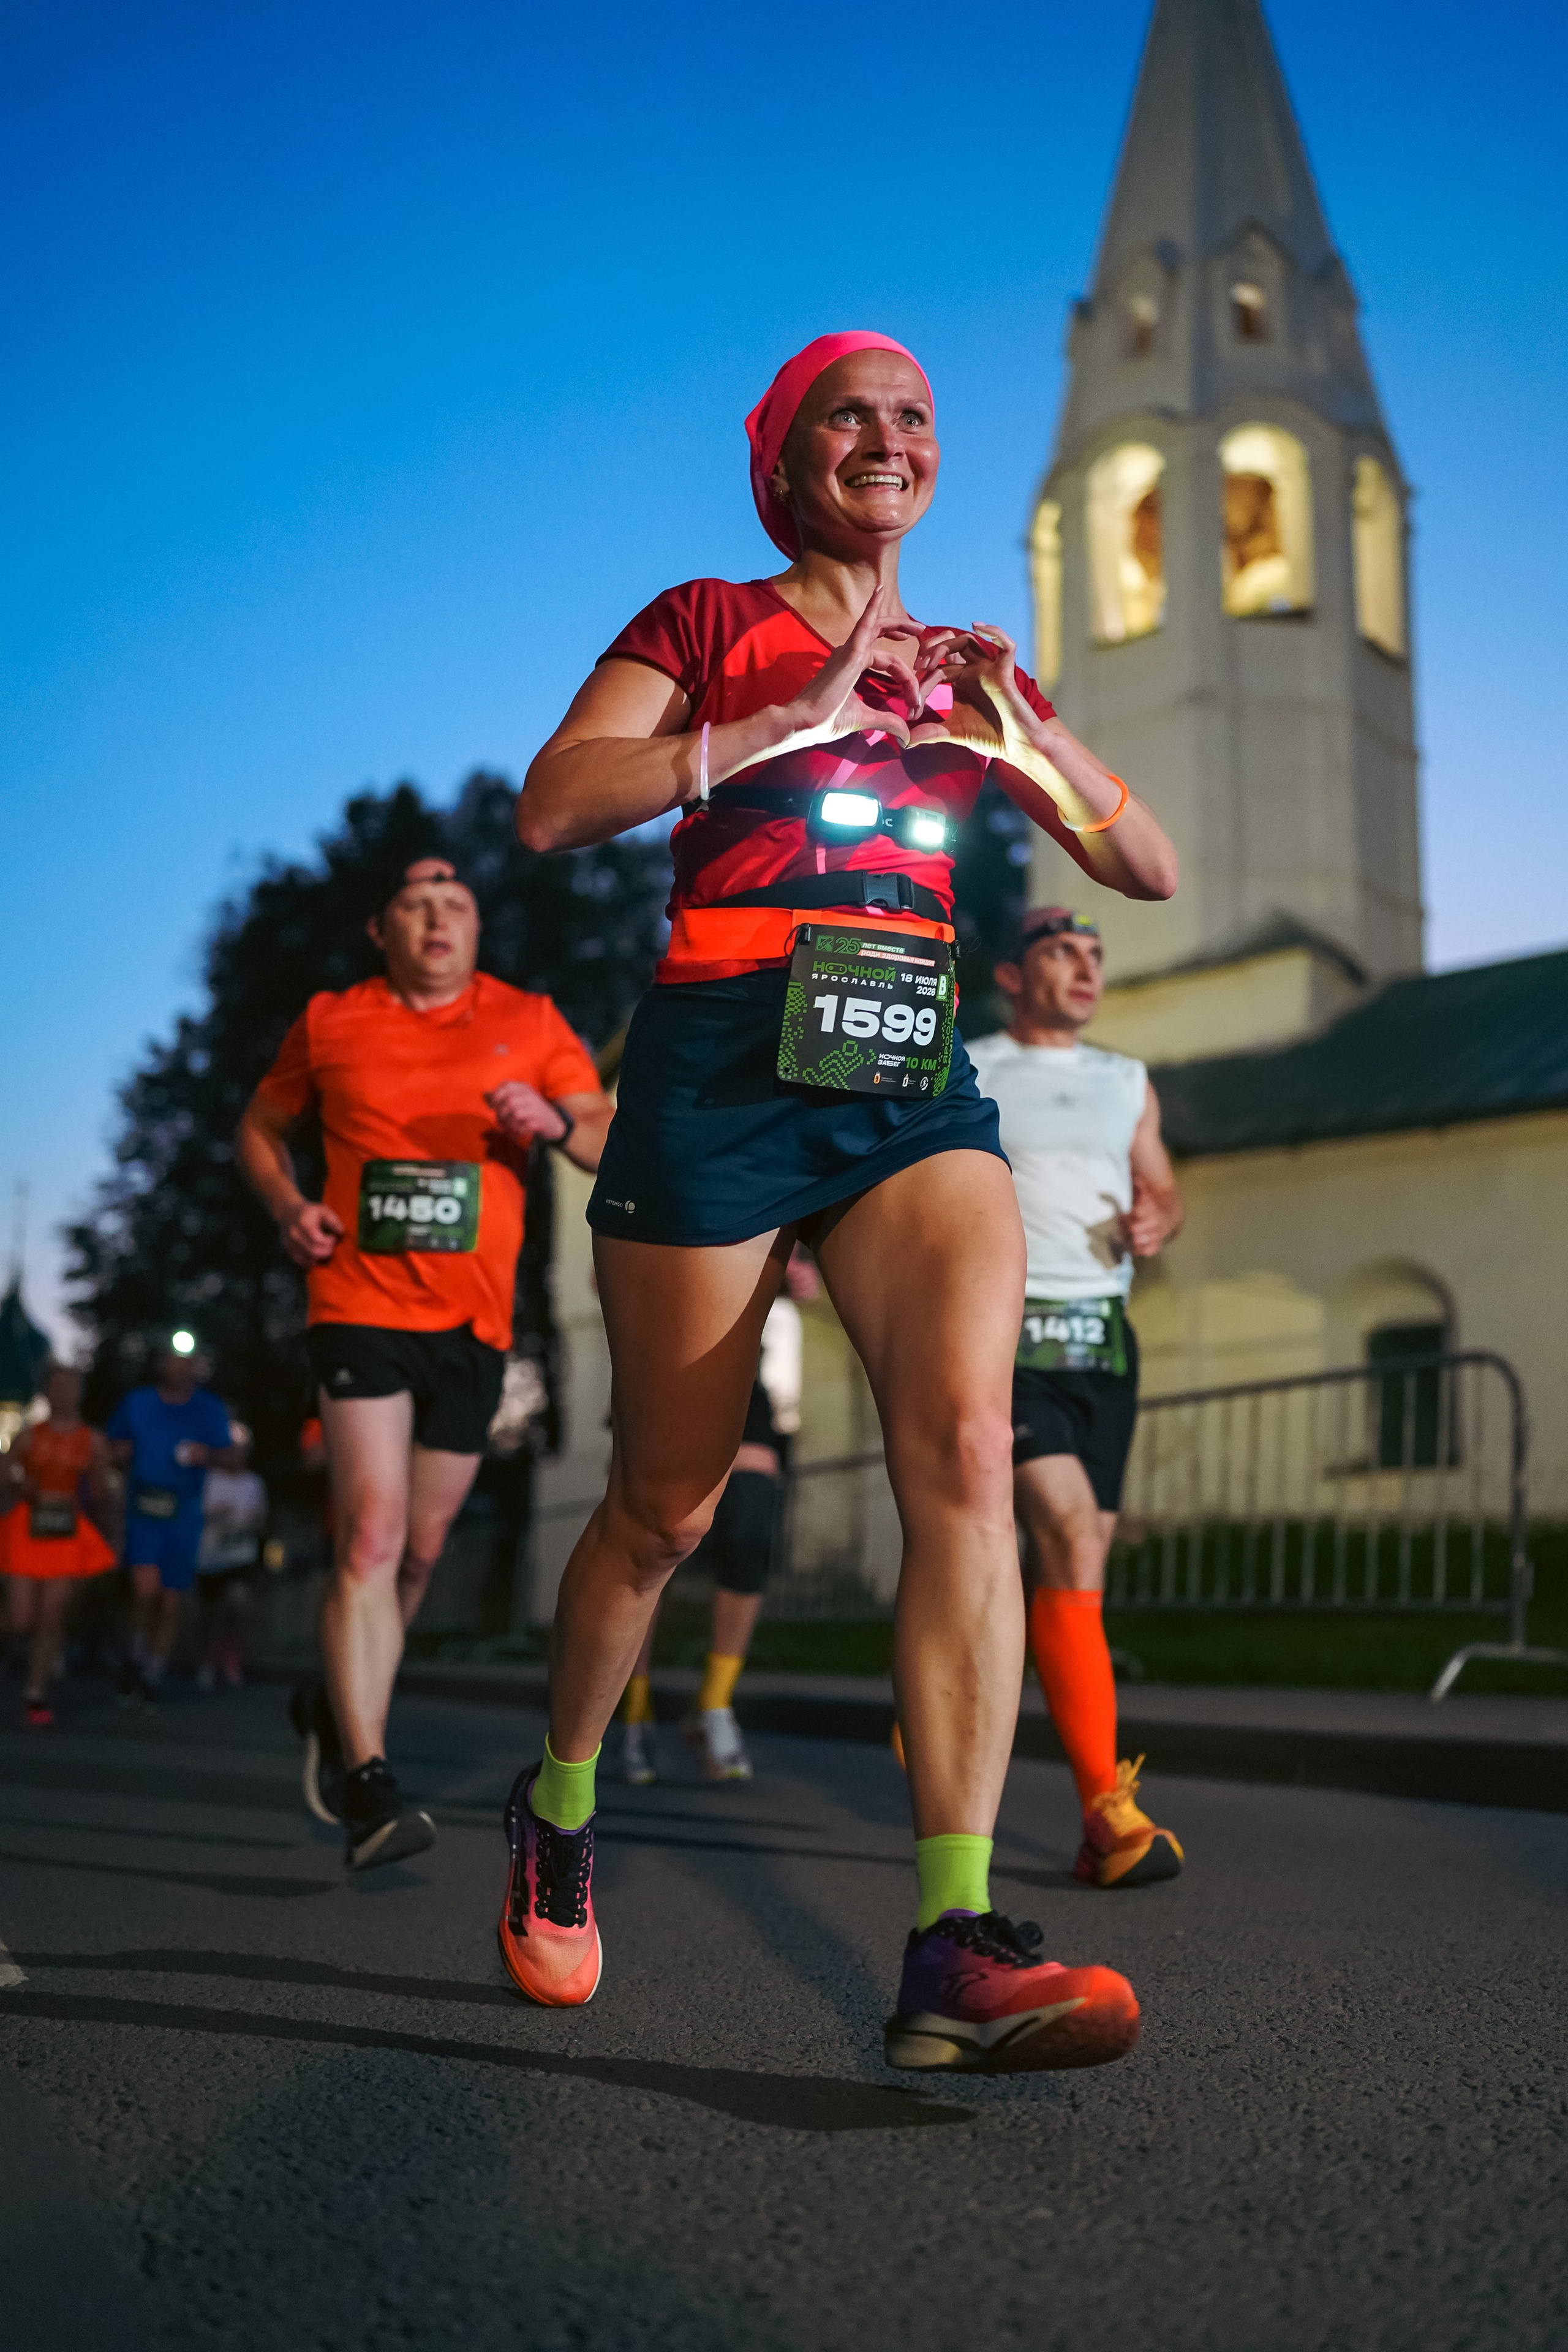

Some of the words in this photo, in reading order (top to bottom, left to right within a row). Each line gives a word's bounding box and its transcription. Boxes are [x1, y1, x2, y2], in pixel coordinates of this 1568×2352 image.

[834, 937, 861, 955] 25
[877, 944, 905, 954] вместе
[881, 952, 914, 963] здоровья
[813, 960, 896, 982] НОЧНОЙ
[812, 973, 893, 989] ЯРОСЛАВЛЬ
[900, 973, 913, 982] 18
[914, 975, 938, 987] ИЮЛЯ
[815, 994, 937, 1046] 1599
[878, 1053, 906, 1061] НОЧНОЙ
[906, 1057, 919, 1069] 10
